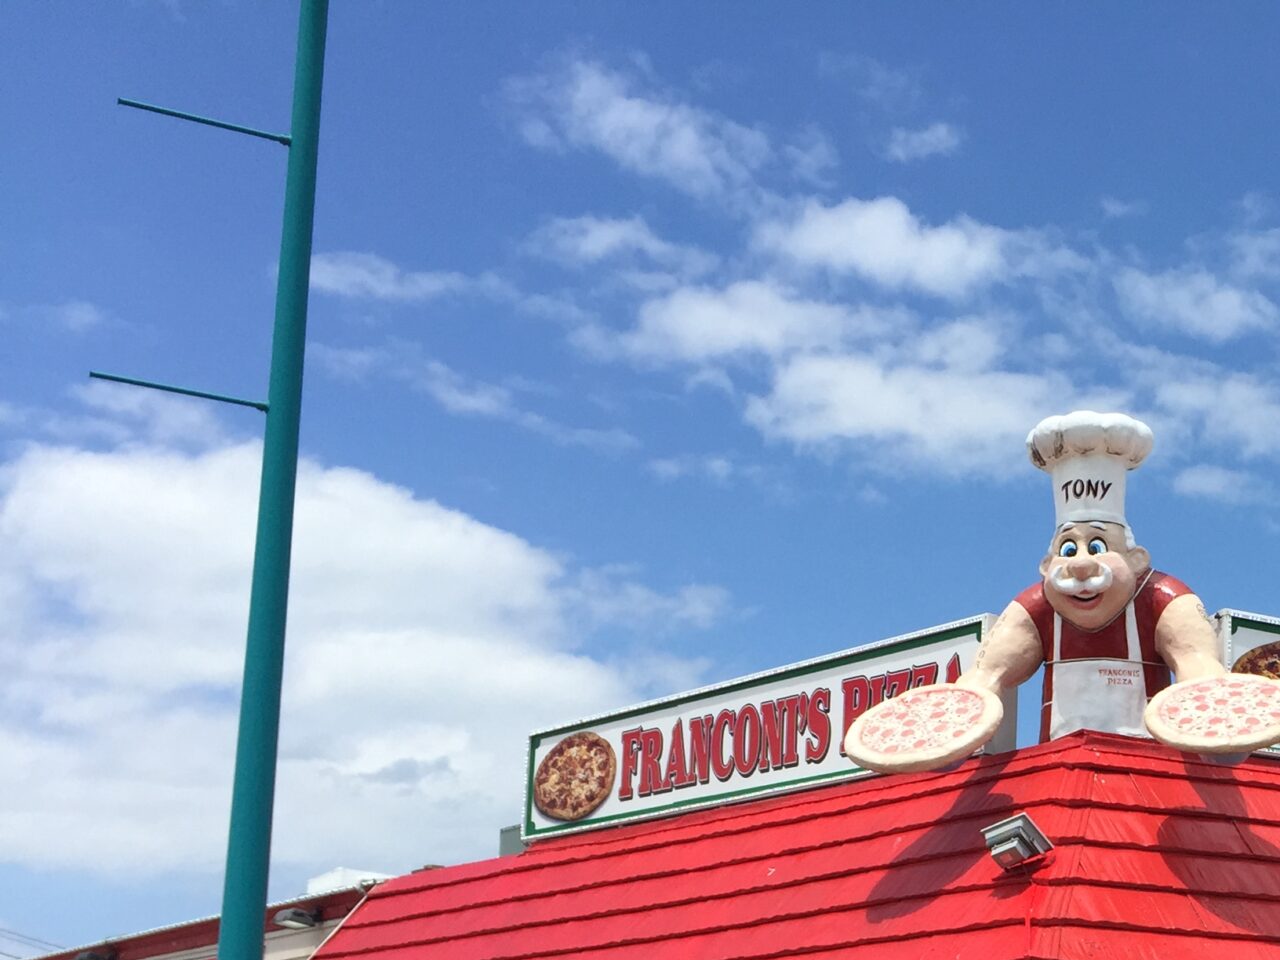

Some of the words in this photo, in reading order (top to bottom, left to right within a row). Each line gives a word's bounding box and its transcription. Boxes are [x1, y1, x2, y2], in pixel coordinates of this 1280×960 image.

[1061, 478, 1112, 503] TONY
[1107, 677, 1133, 687] PIZZA
[618, 687, 831, 801] FRANCONI'S
